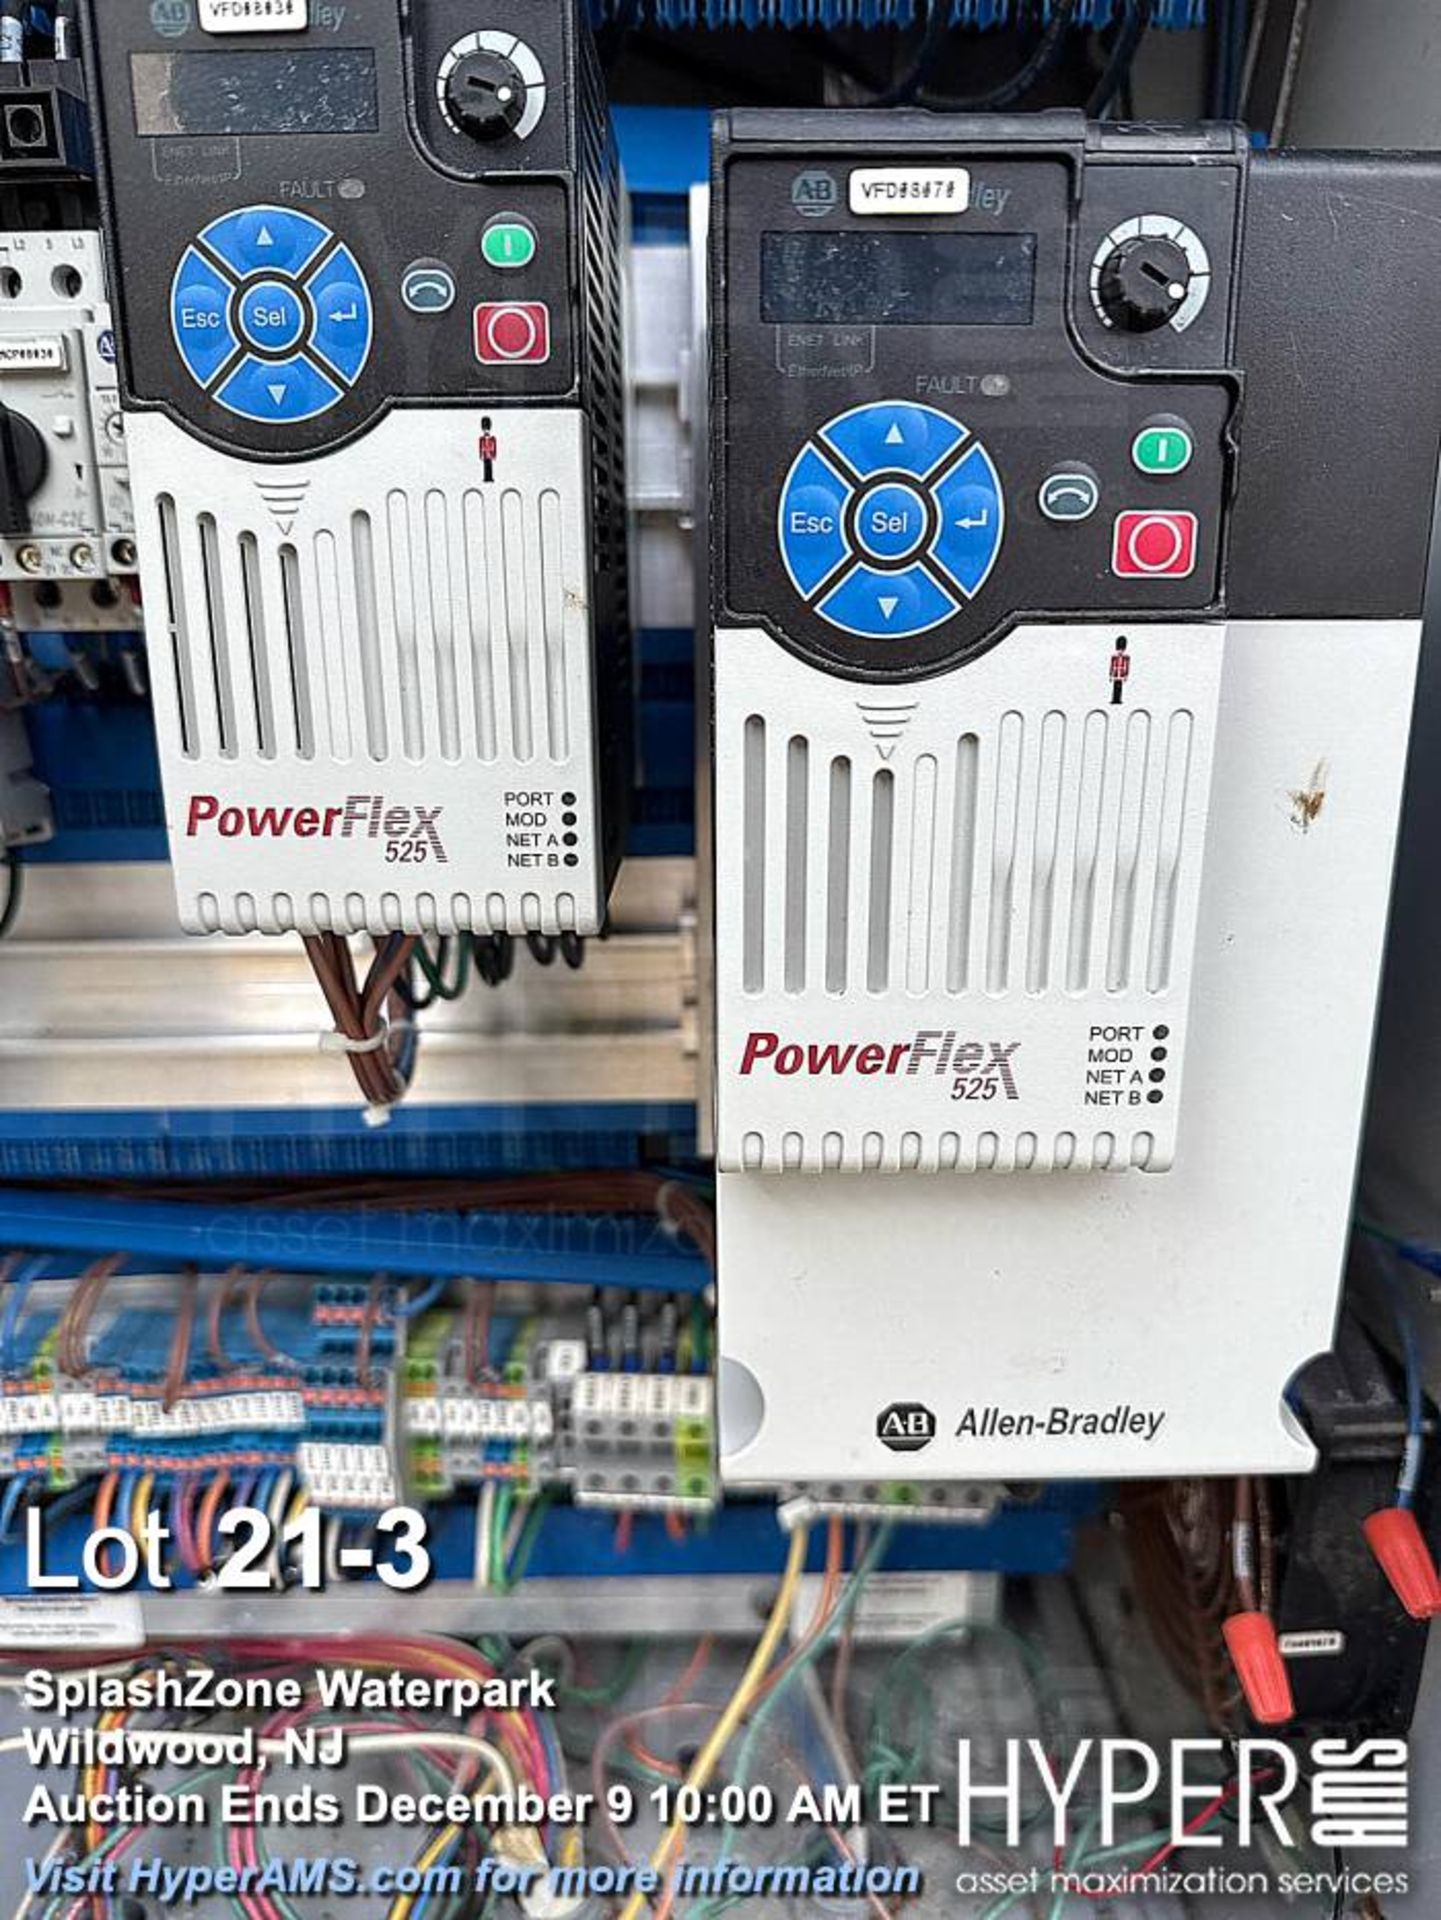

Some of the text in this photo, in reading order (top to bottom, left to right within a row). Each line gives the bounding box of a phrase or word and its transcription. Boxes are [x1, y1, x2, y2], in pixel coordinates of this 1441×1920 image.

[279, 180, 335, 199] FAULT
[180, 307, 221, 330] Esc
[252, 305, 288, 329] Sel
[916, 376, 979, 395] FAULT
[790, 511, 833, 535] Esc
[871, 508, 909, 534] Sel
[504, 792, 554, 807] PORT
[186, 795, 448, 863] PowerFlex
[505, 812, 547, 827] MOD
[507, 833, 559, 847] NET A
[385, 840, 428, 863] 525
[507, 853, 559, 868] NET B
[1090, 1026, 1145, 1042] PORT
[1088, 1048, 1133, 1063] MOD
[739, 1031, 1021, 1101] PowerFlex
[1086, 1069, 1144, 1084] NET A
[950, 1077, 999, 1100] 525
[1084, 1090, 1142, 1106] NET B
[955, 1405, 1166, 1441] Allen-Bradley
